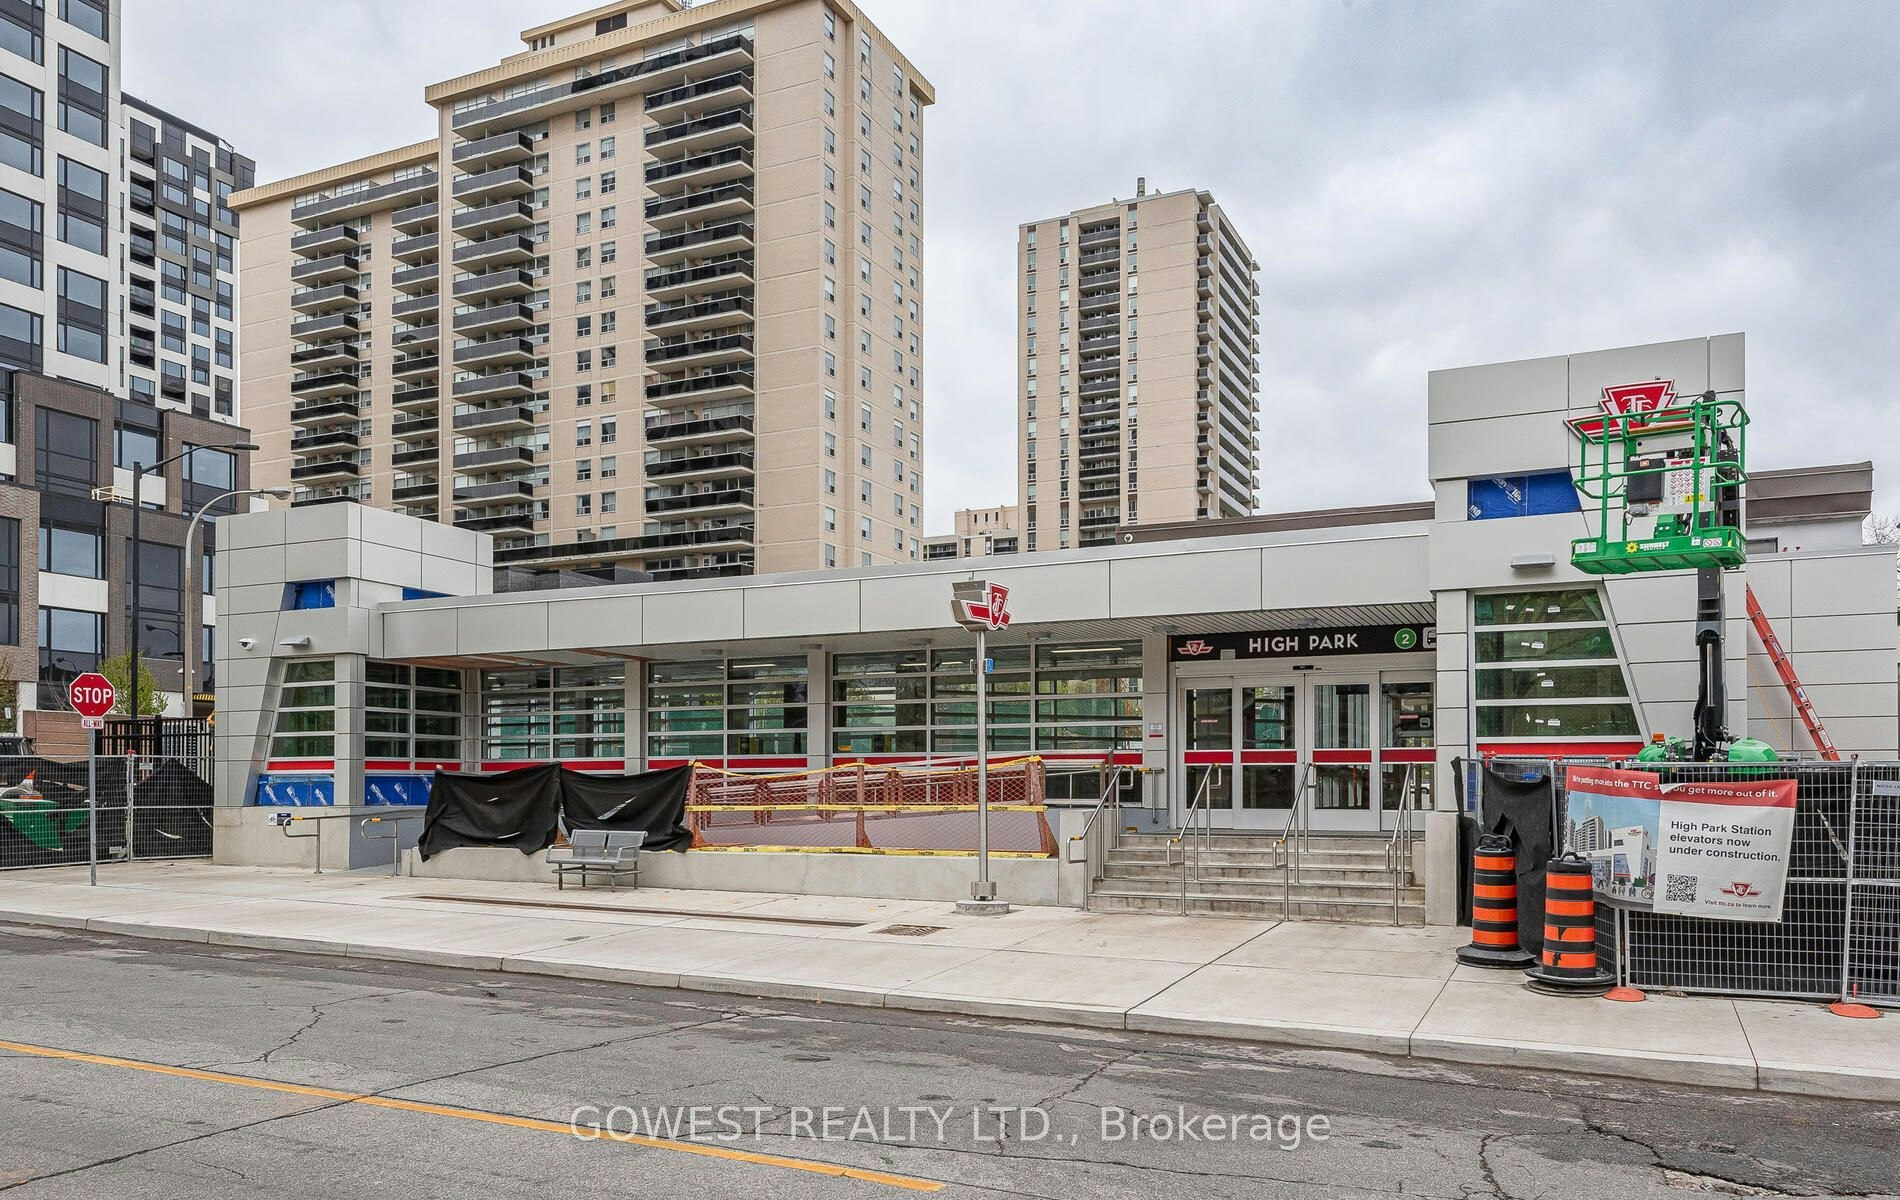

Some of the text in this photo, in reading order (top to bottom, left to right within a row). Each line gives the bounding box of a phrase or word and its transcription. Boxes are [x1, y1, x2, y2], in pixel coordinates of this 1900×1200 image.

[1249, 633, 1410, 653] HIGH PARK 2
[73, 687, 113, 704] STOP
[1614, 779, 1630, 788] the
[1632, 780, 1652, 790] TTC
[1688, 786, 1705, 795] get
[1736, 790, 1752, 798] out
[1754, 789, 1766, 798] of
[1768, 789, 1778, 798] it.
[1671, 821, 1772, 836] High Park Station
[1670, 833, 1751, 847] elevators now
[1669, 846, 1781, 862] under construction.
